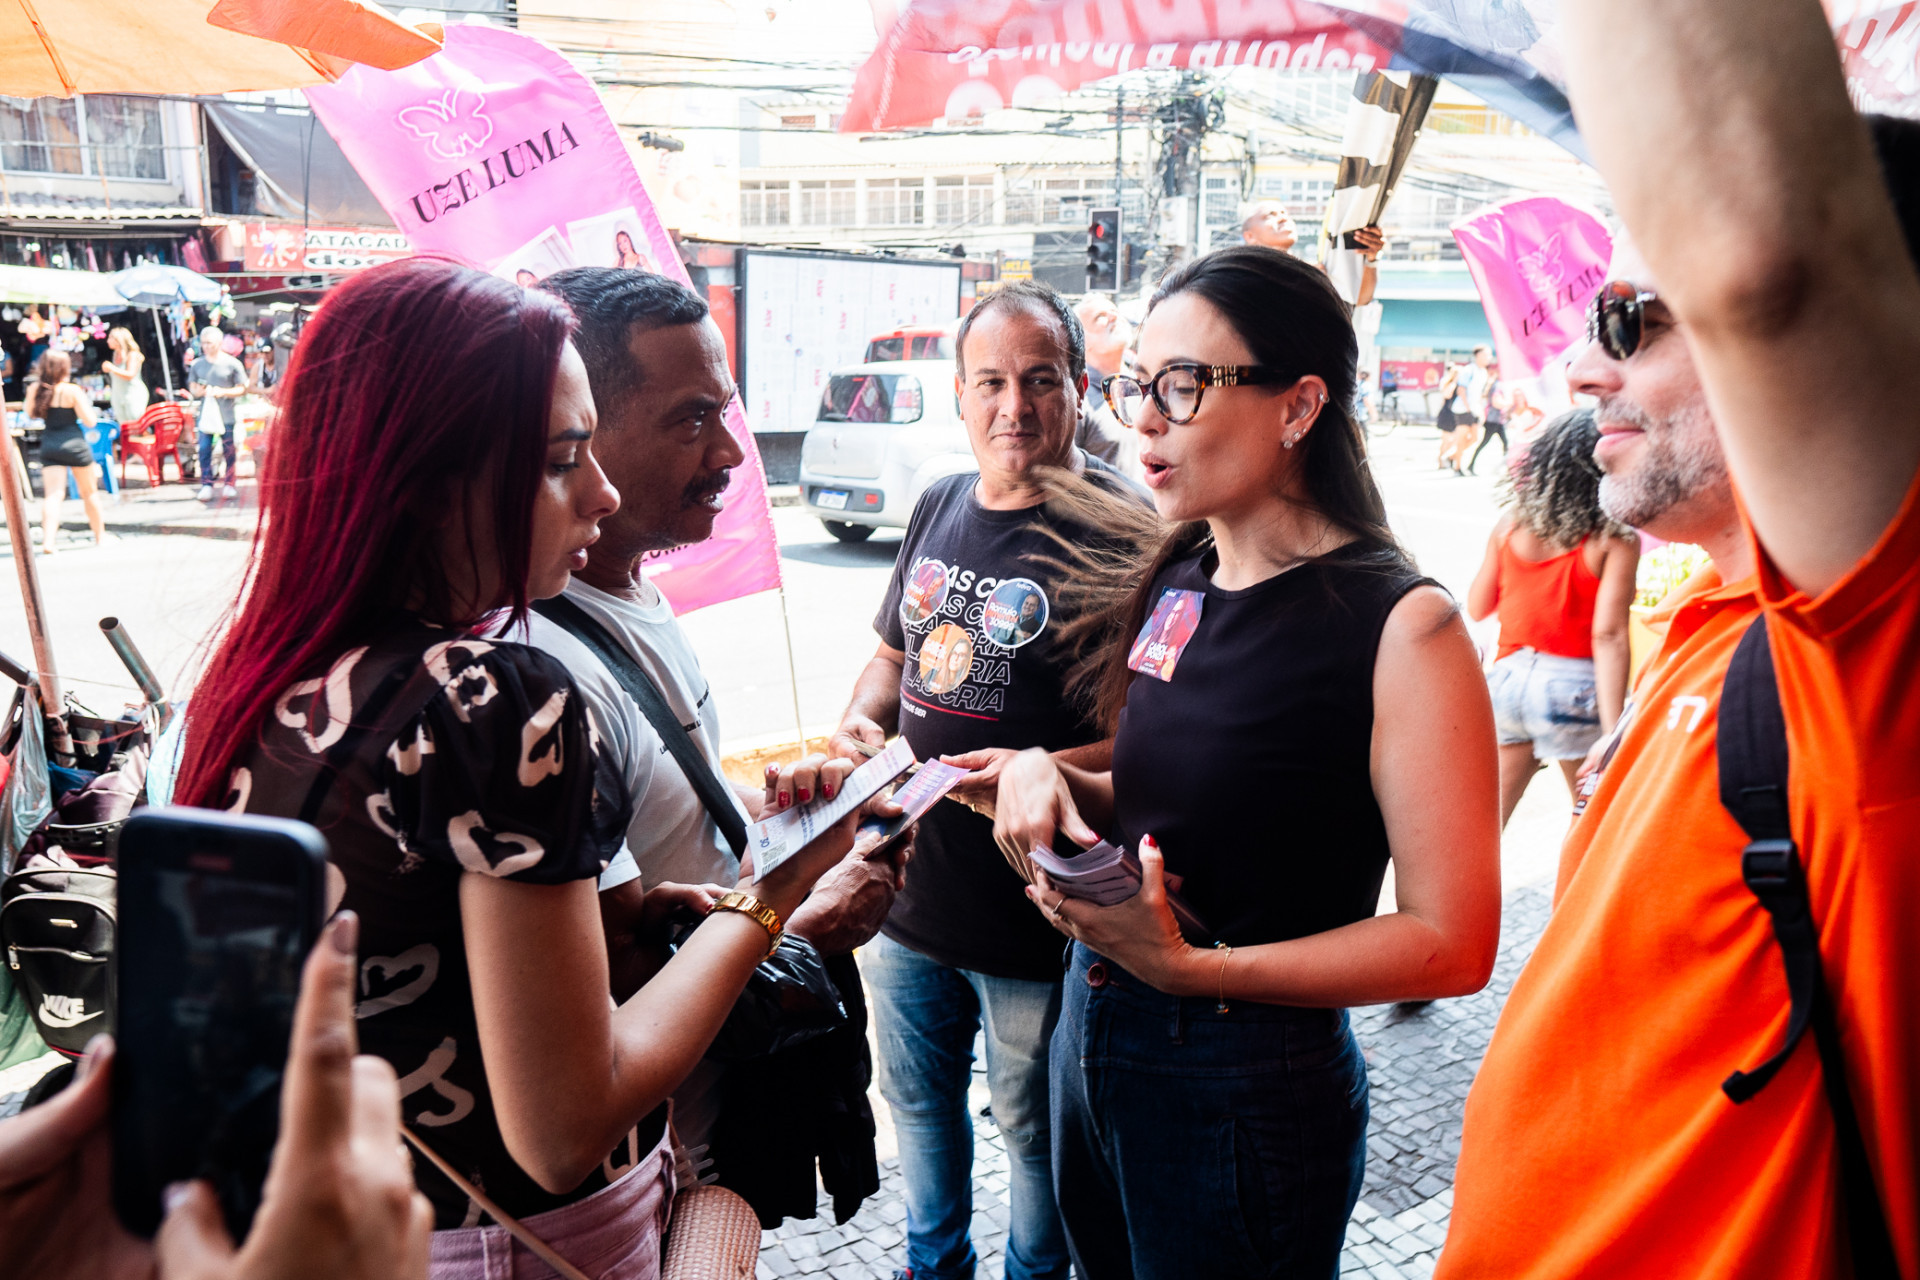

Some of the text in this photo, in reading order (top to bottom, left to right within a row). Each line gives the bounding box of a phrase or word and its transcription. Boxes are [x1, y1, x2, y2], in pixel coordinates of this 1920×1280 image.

[409, 121, 580, 223] UZE LUMA
[43, 993, 85, 1020] NIKE
